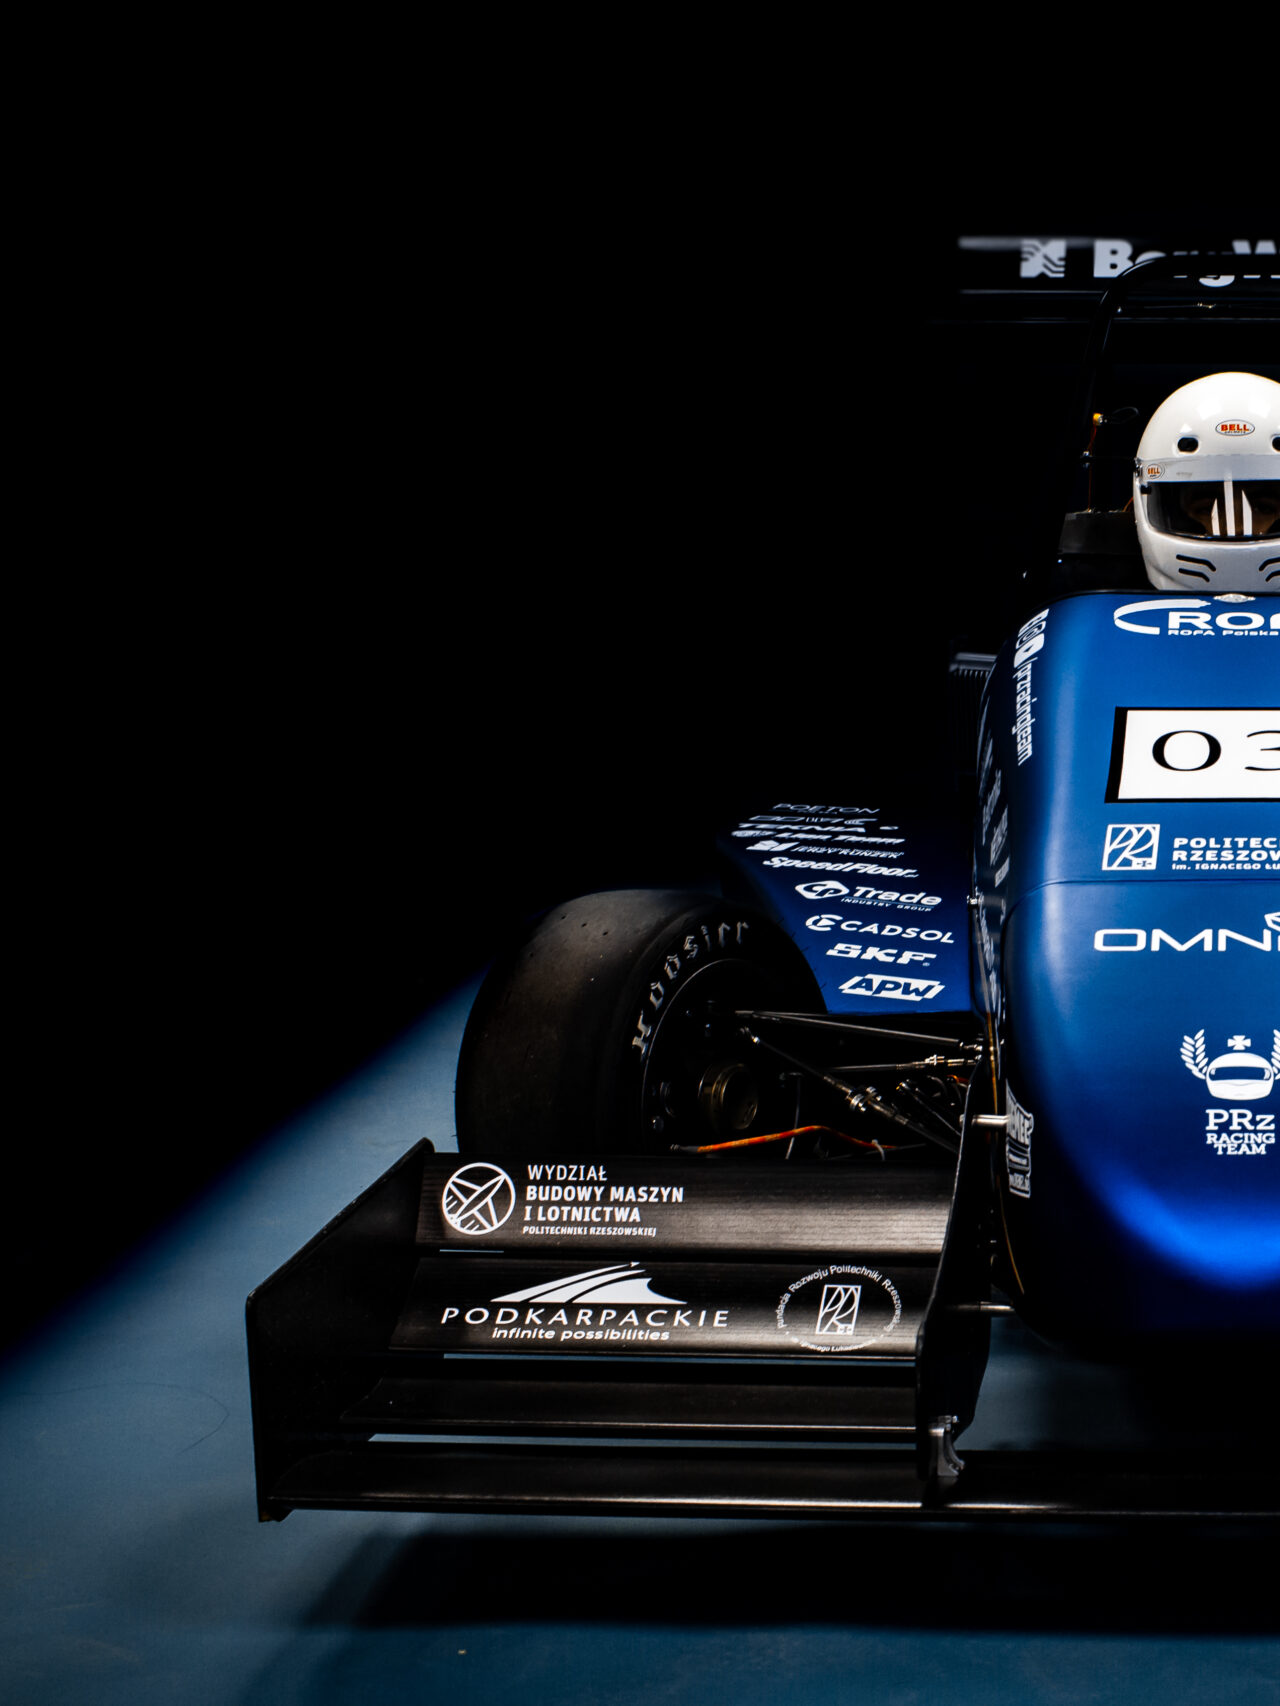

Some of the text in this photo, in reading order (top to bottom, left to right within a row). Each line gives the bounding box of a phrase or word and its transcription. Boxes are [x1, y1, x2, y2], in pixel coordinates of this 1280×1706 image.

[1171, 863, 1191, 871] im.
[1195, 863, 1261, 871] IGNACEGO
[853, 886, 943, 906] Trade
[840, 919, 955, 944] CADSOL
[845, 976, 937, 998] APW
[1205, 1108, 1276, 1131] PRz
[1206, 1132, 1276, 1145] RACING
[1213, 1143, 1267, 1155] TEAM
[527, 1164, 608, 1181] WYDZIAŁ
[526, 1185, 685, 1203] BUDOWY MASZYN
[524, 1205, 641, 1222] I LOTNICTWA
[522, 1225, 657, 1238] POLITECHNIKI RZESZOWSKIEJ
[441, 1307, 729, 1328] PODKARPACKIE
[492, 1327, 670, 1342] infinite possibilities
